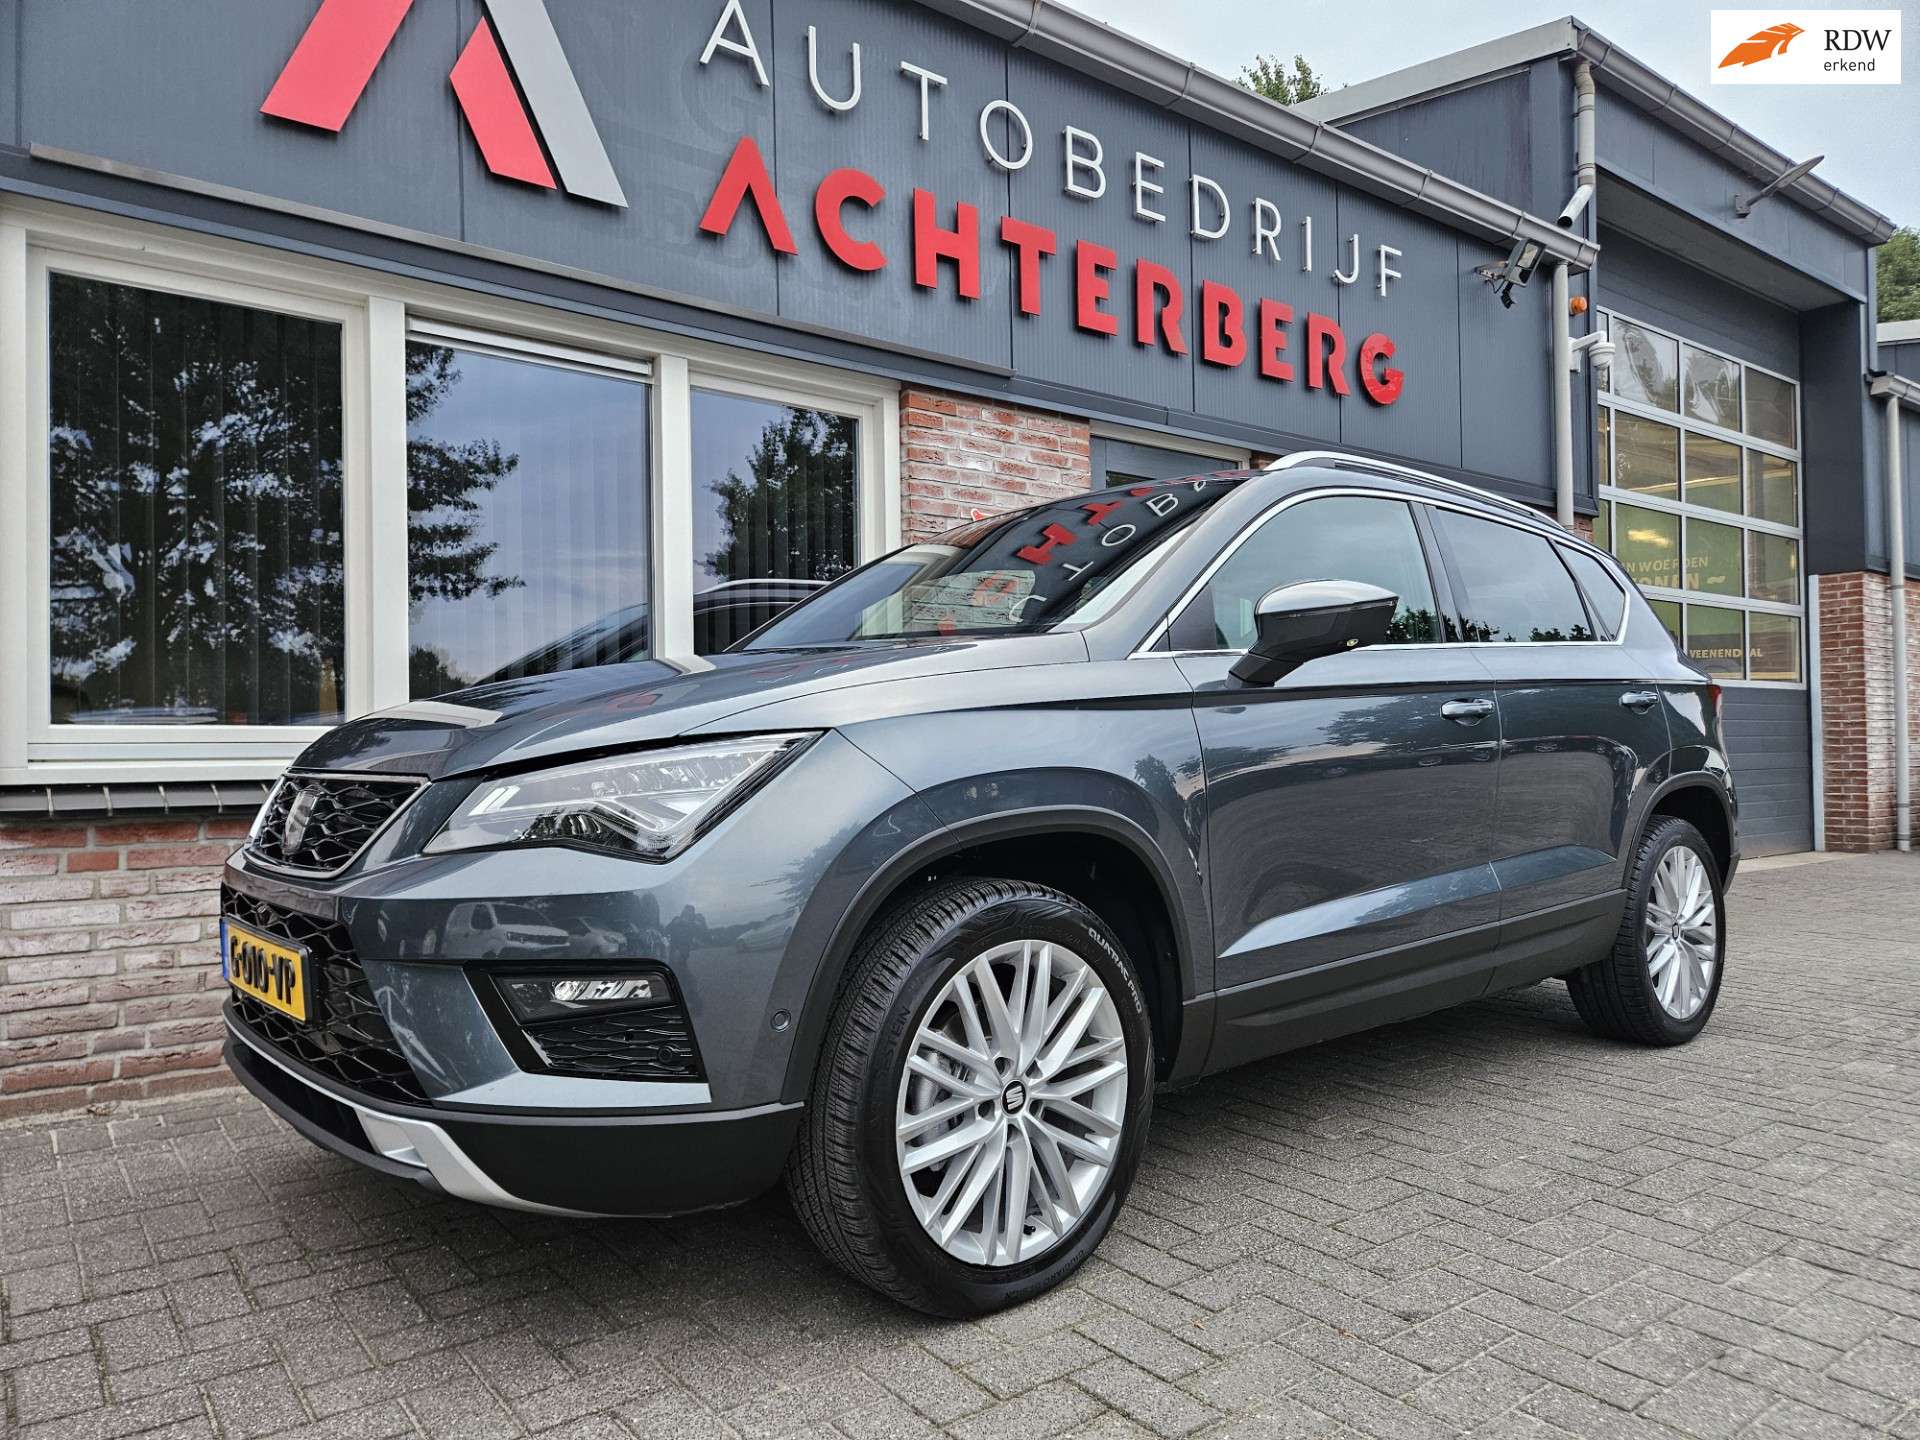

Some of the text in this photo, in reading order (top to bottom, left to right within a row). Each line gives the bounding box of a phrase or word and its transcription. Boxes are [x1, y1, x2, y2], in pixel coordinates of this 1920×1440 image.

[699, 0, 1402, 297] AUTOBEDRIJF
[698, 136, 1404, 406] ACHTERBERG
[1689, 648, 1763, 659] VEENENDAL
[1088, 927, 1142, 1014] QUATRAC PRO
